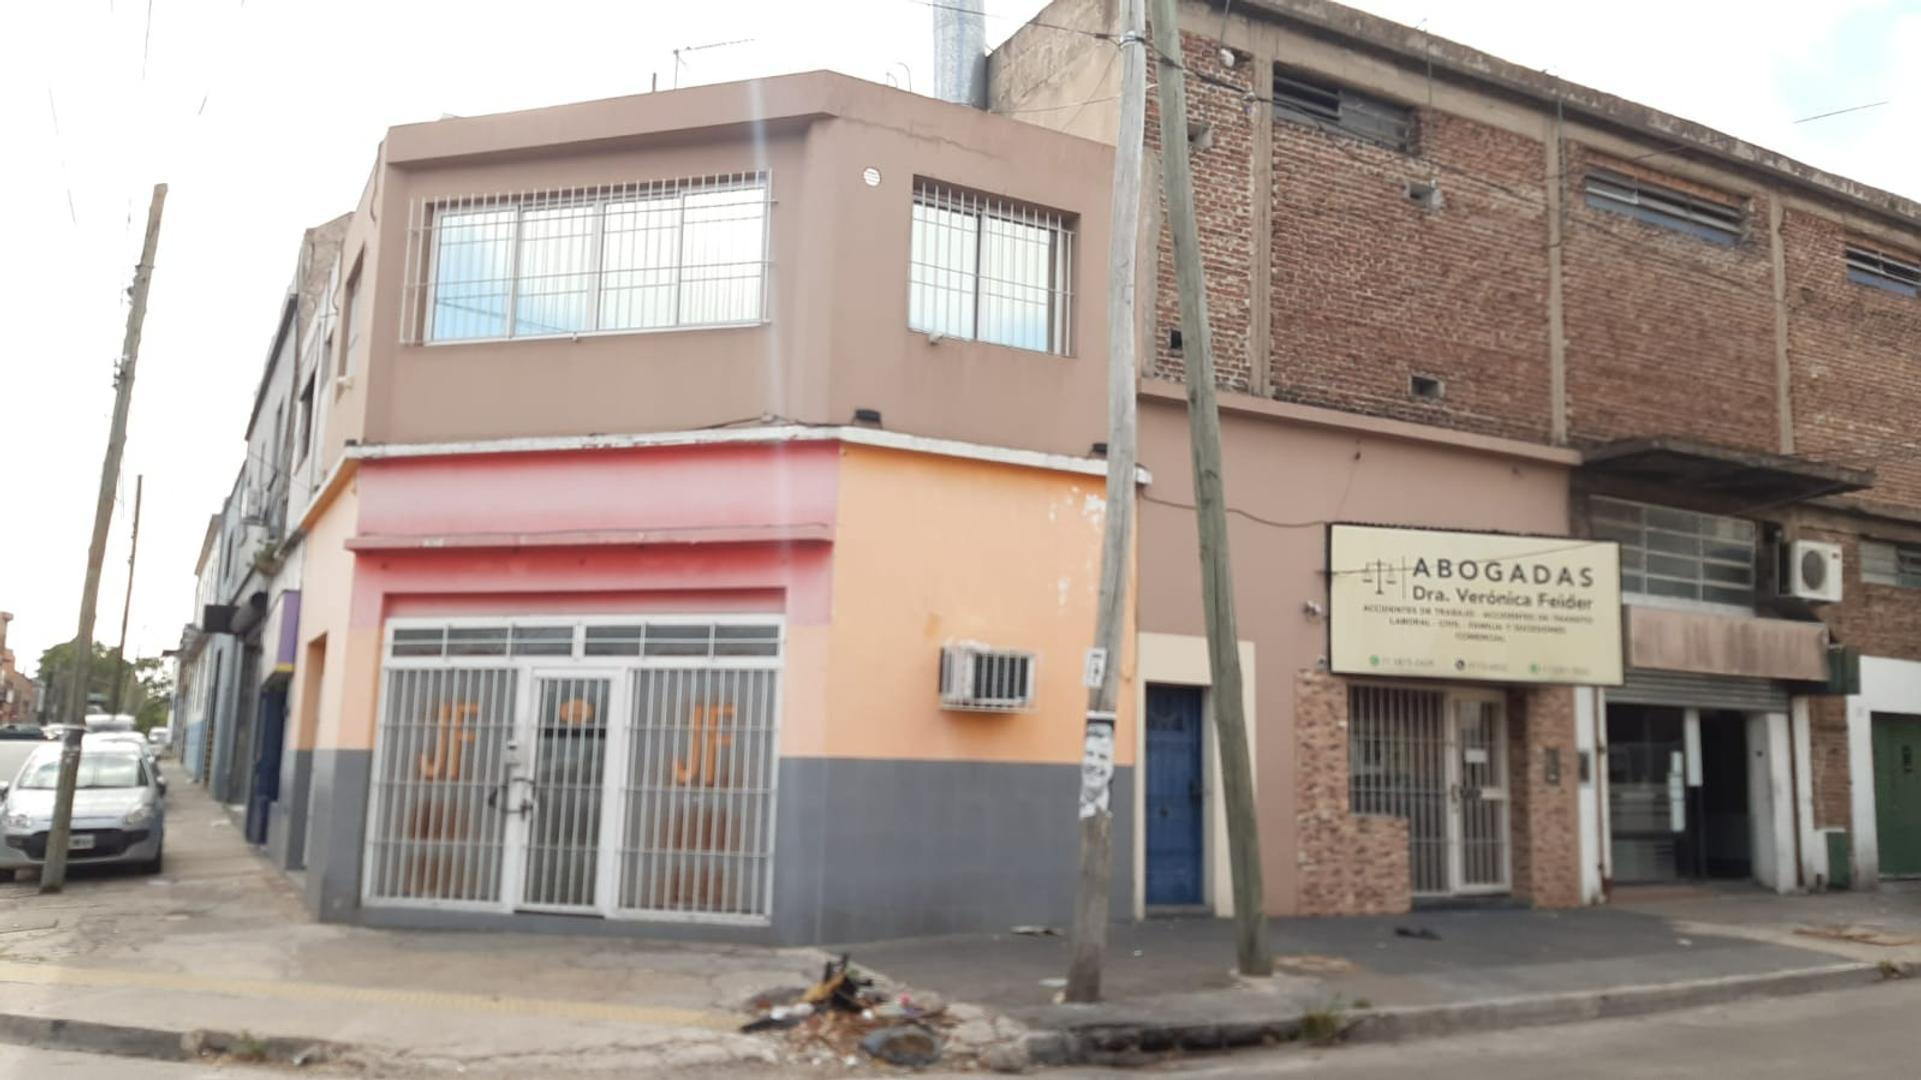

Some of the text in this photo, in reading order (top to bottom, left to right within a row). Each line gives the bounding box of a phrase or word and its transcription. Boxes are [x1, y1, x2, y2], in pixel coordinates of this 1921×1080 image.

[1412, 557, 1594, 588] ABOGADAS
[1412, 585, 1450, 602] Dra.
[1456, 587, 1532, 607] Verónica
